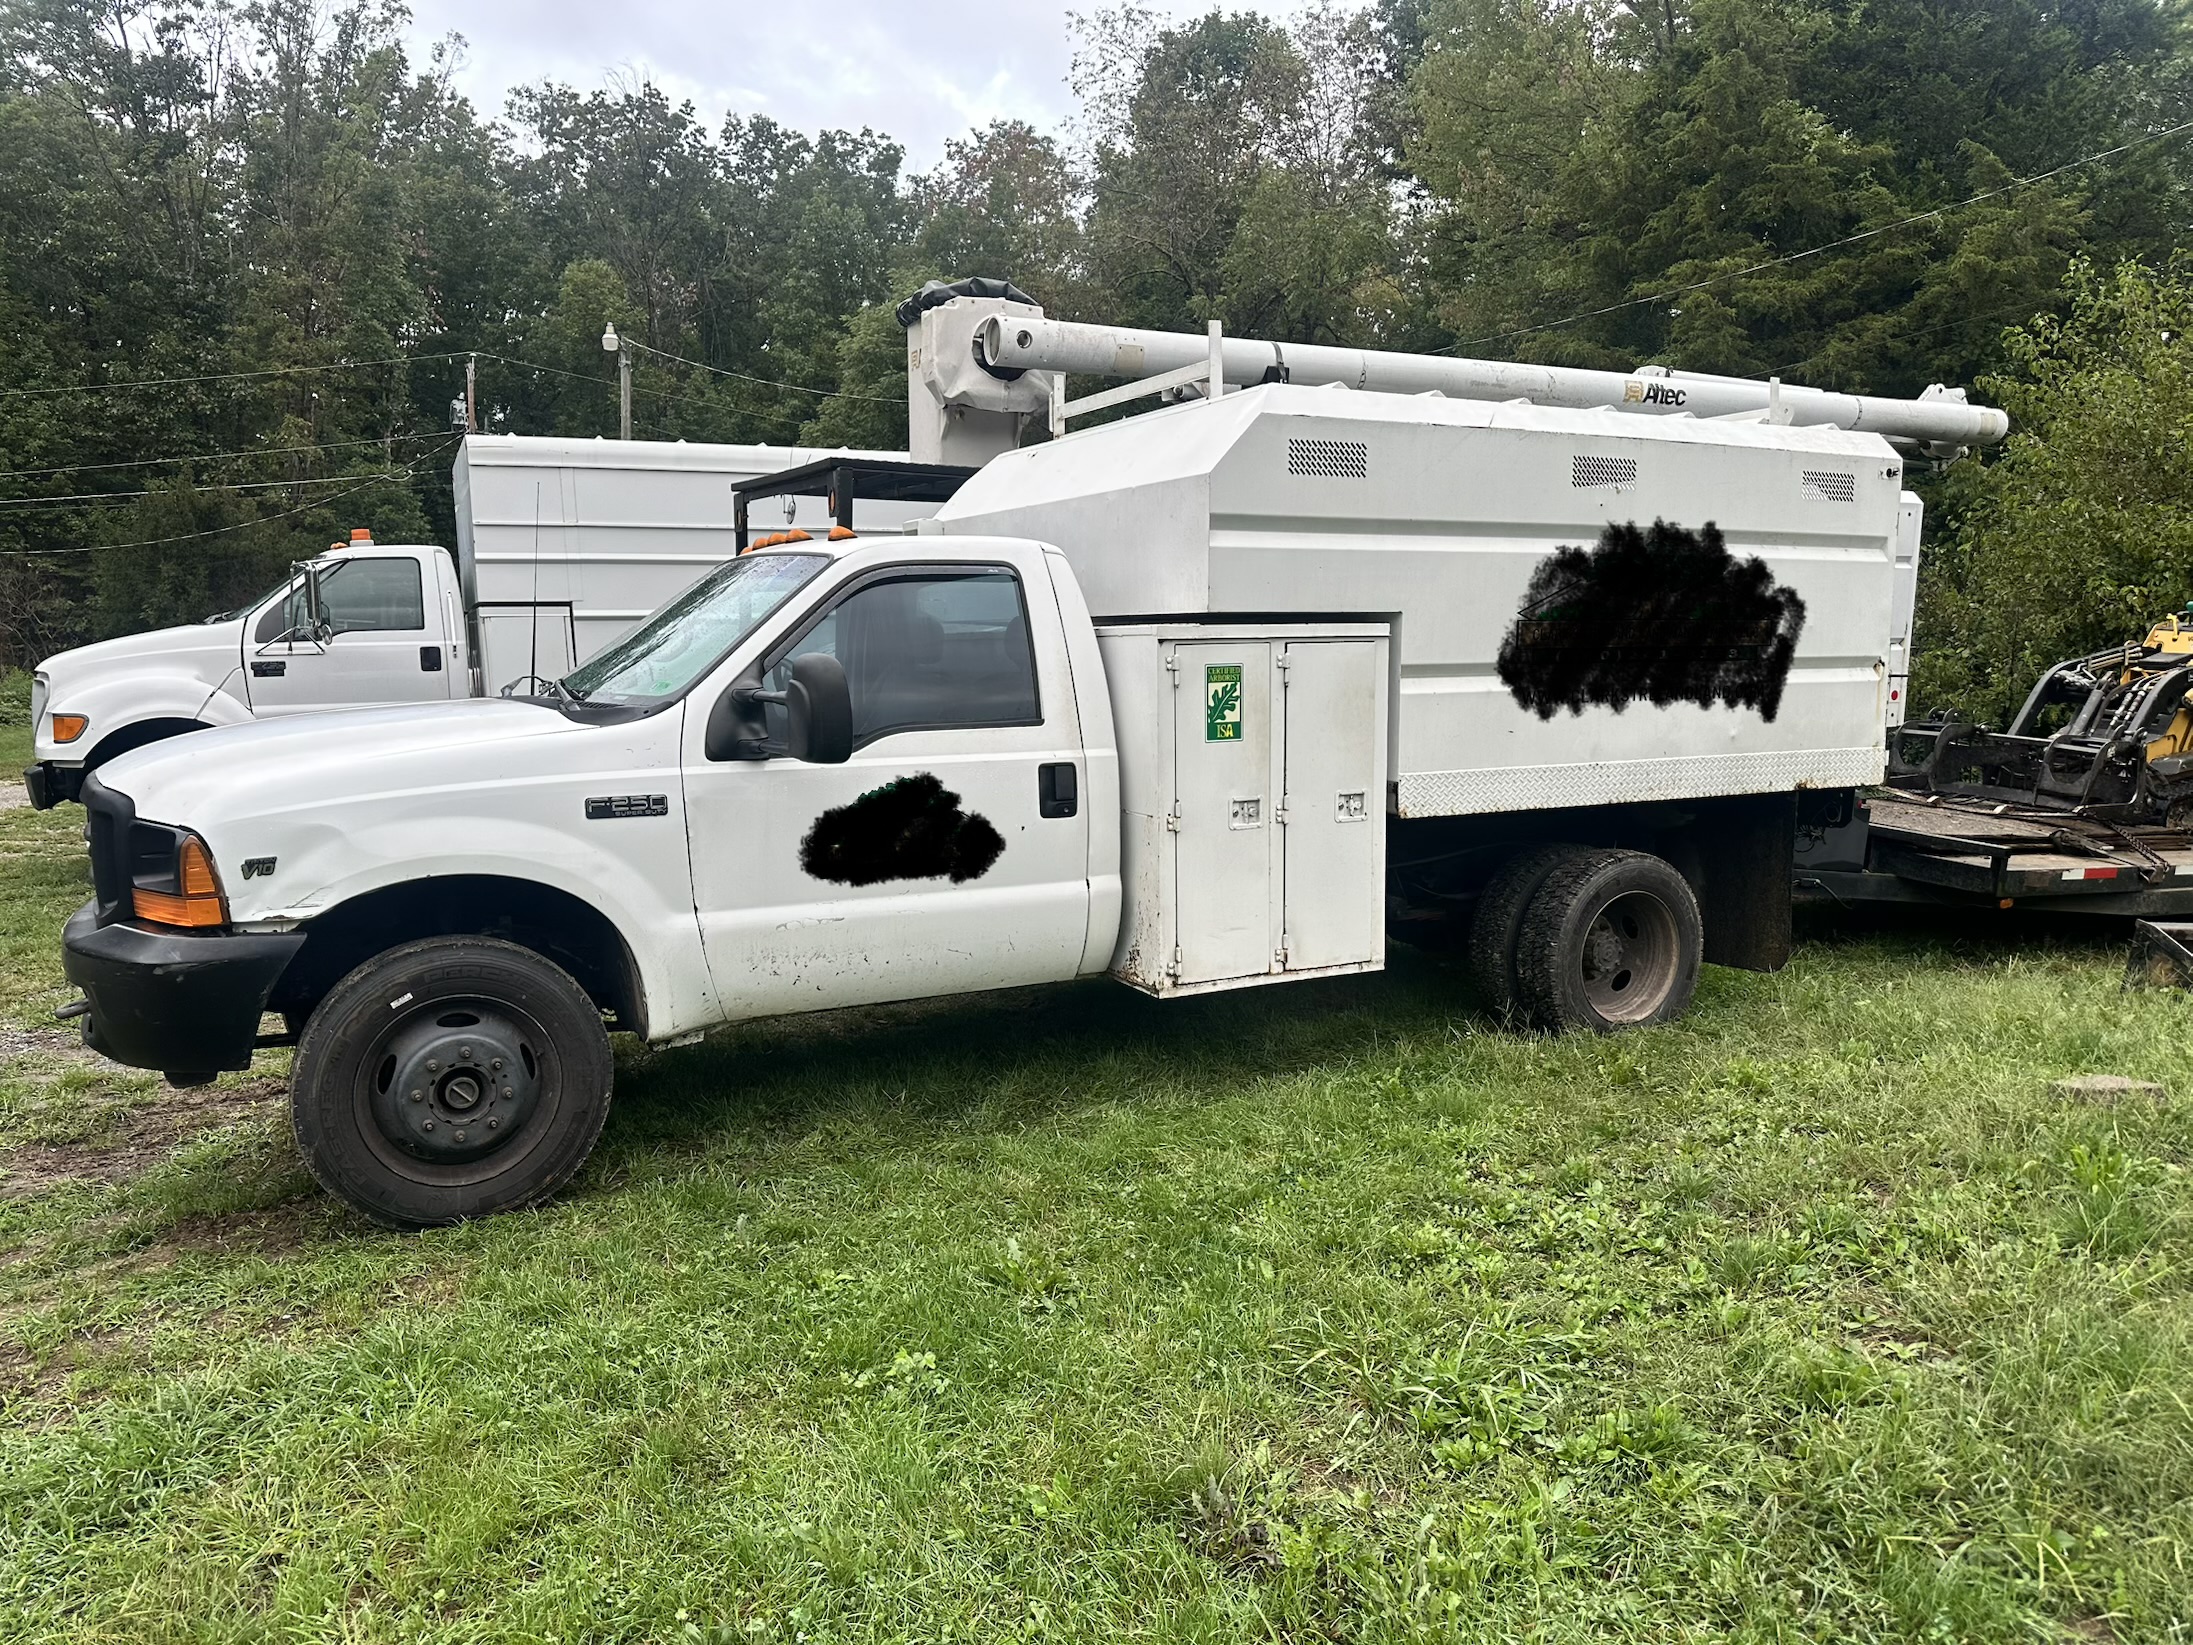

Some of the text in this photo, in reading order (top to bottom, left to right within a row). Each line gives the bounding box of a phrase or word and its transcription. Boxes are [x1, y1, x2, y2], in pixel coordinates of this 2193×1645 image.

[1642, 383, 1687, 406] Altec
[1208, 667, 1240, 675] CERTIFIED
[1217, 724, 1234, 738] ISA
[241, 863, 275, 880] V10
